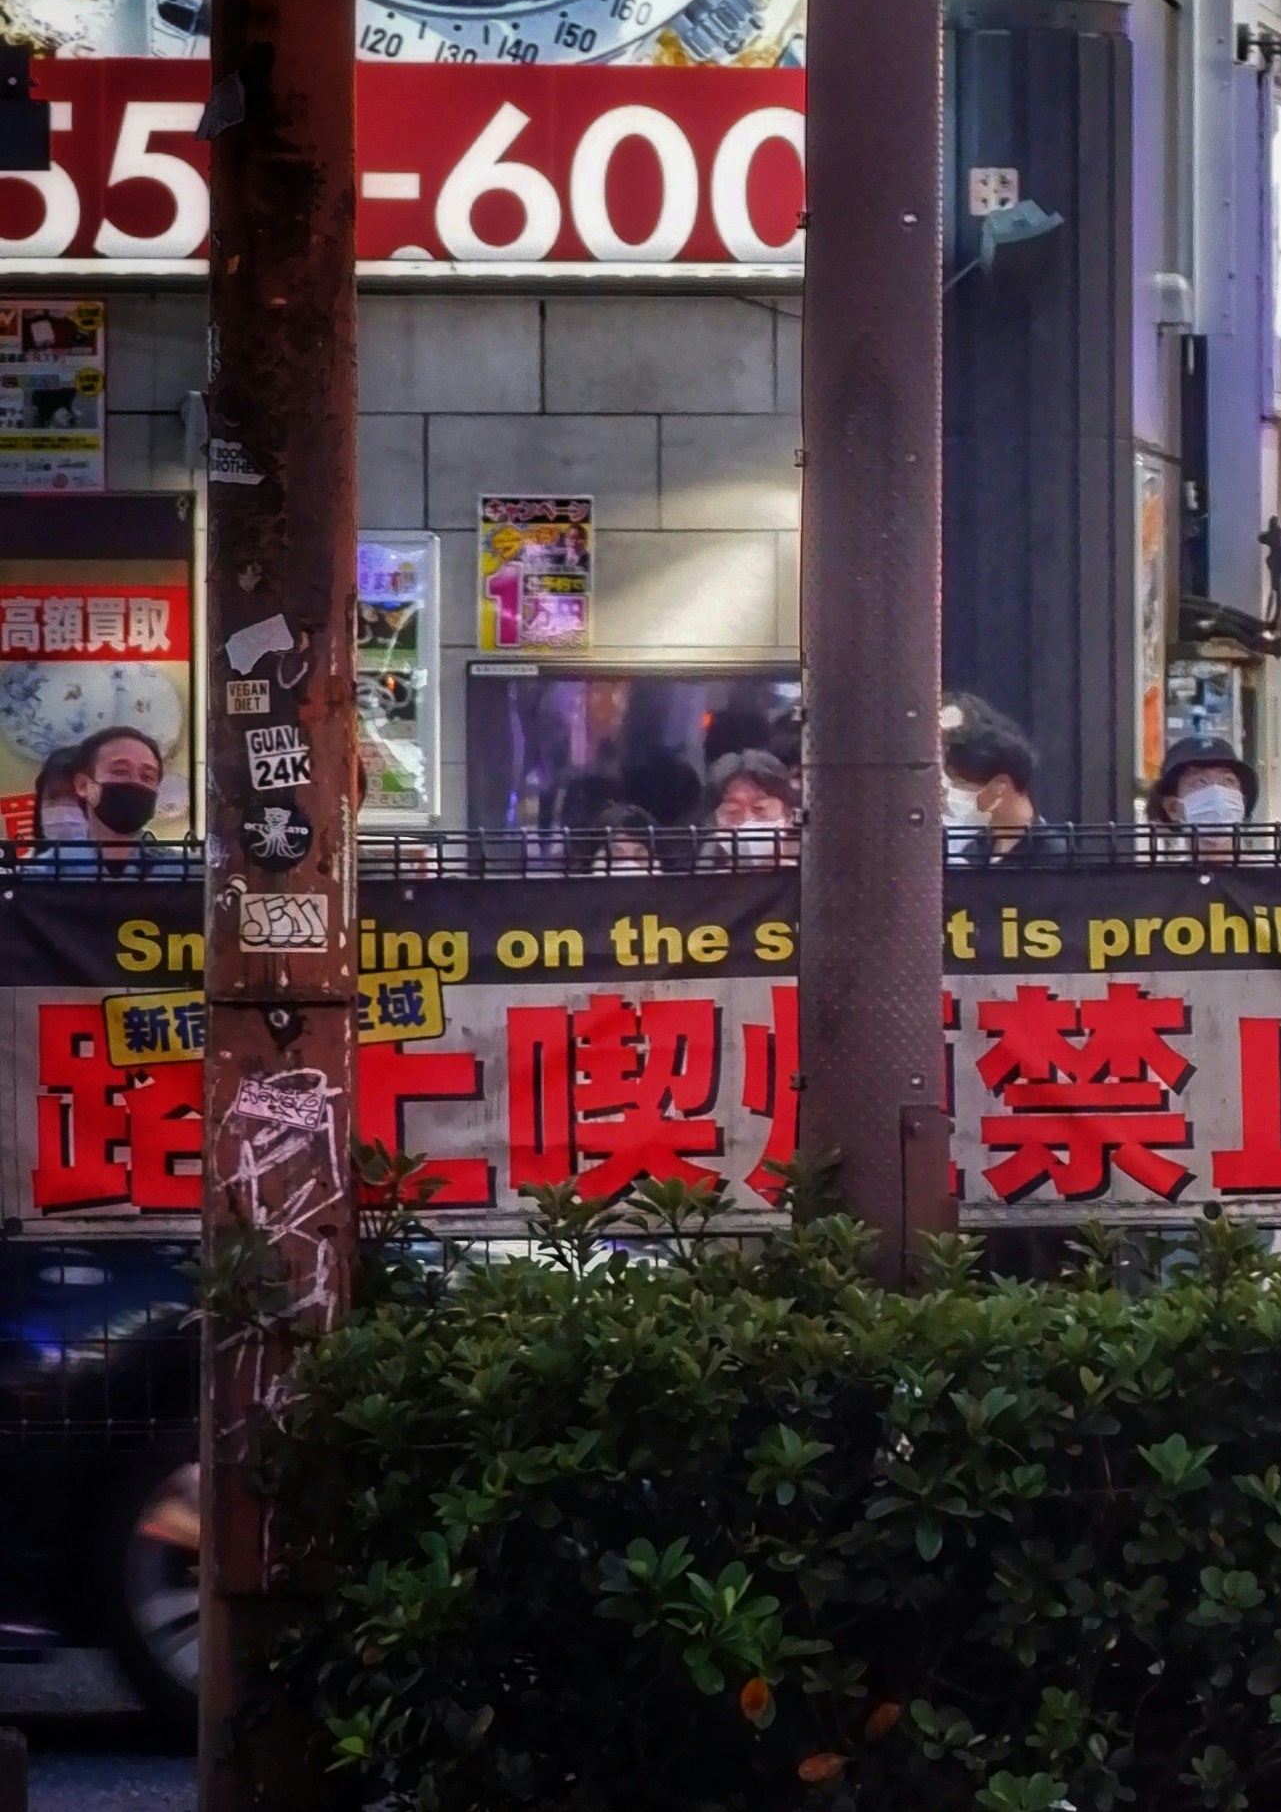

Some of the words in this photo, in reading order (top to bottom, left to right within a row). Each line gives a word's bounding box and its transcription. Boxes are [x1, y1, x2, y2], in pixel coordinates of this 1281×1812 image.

[359, 25, 402, 58] 120
[434, 38, 479, 63] 130
[498, 37, 539, 65] 140
[553, 20, 598, 53] 150
[1, 597, 171, 653] 高額買取
[229, 682, 268, 696] VEGAN
[234, 697, 261, 712] DIET
[255, 755, 311, 788] 24K
[117, 917, 470, 982] Sming
[497, 925, 584, 968] on
[610, 916, 730, 965] the
[1001, 907, 1062, 959] is
